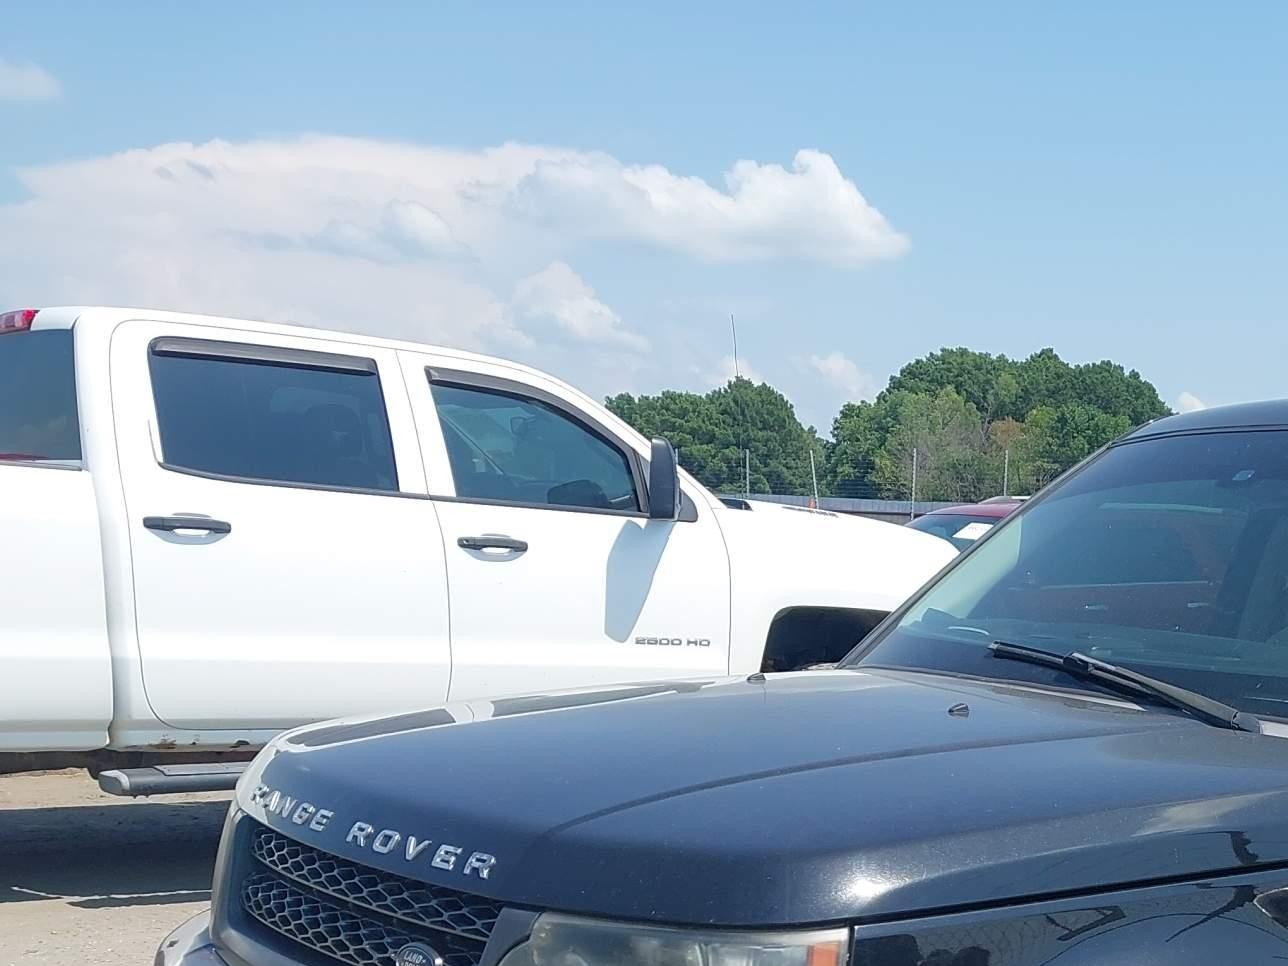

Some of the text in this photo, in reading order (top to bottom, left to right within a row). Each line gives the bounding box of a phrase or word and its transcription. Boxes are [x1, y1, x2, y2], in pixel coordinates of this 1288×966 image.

[635, 637, 711, 647] 2500 HD
[250, 784, 497, 880] RANGE ROVER
[403, 951, 424, 965] LAND
